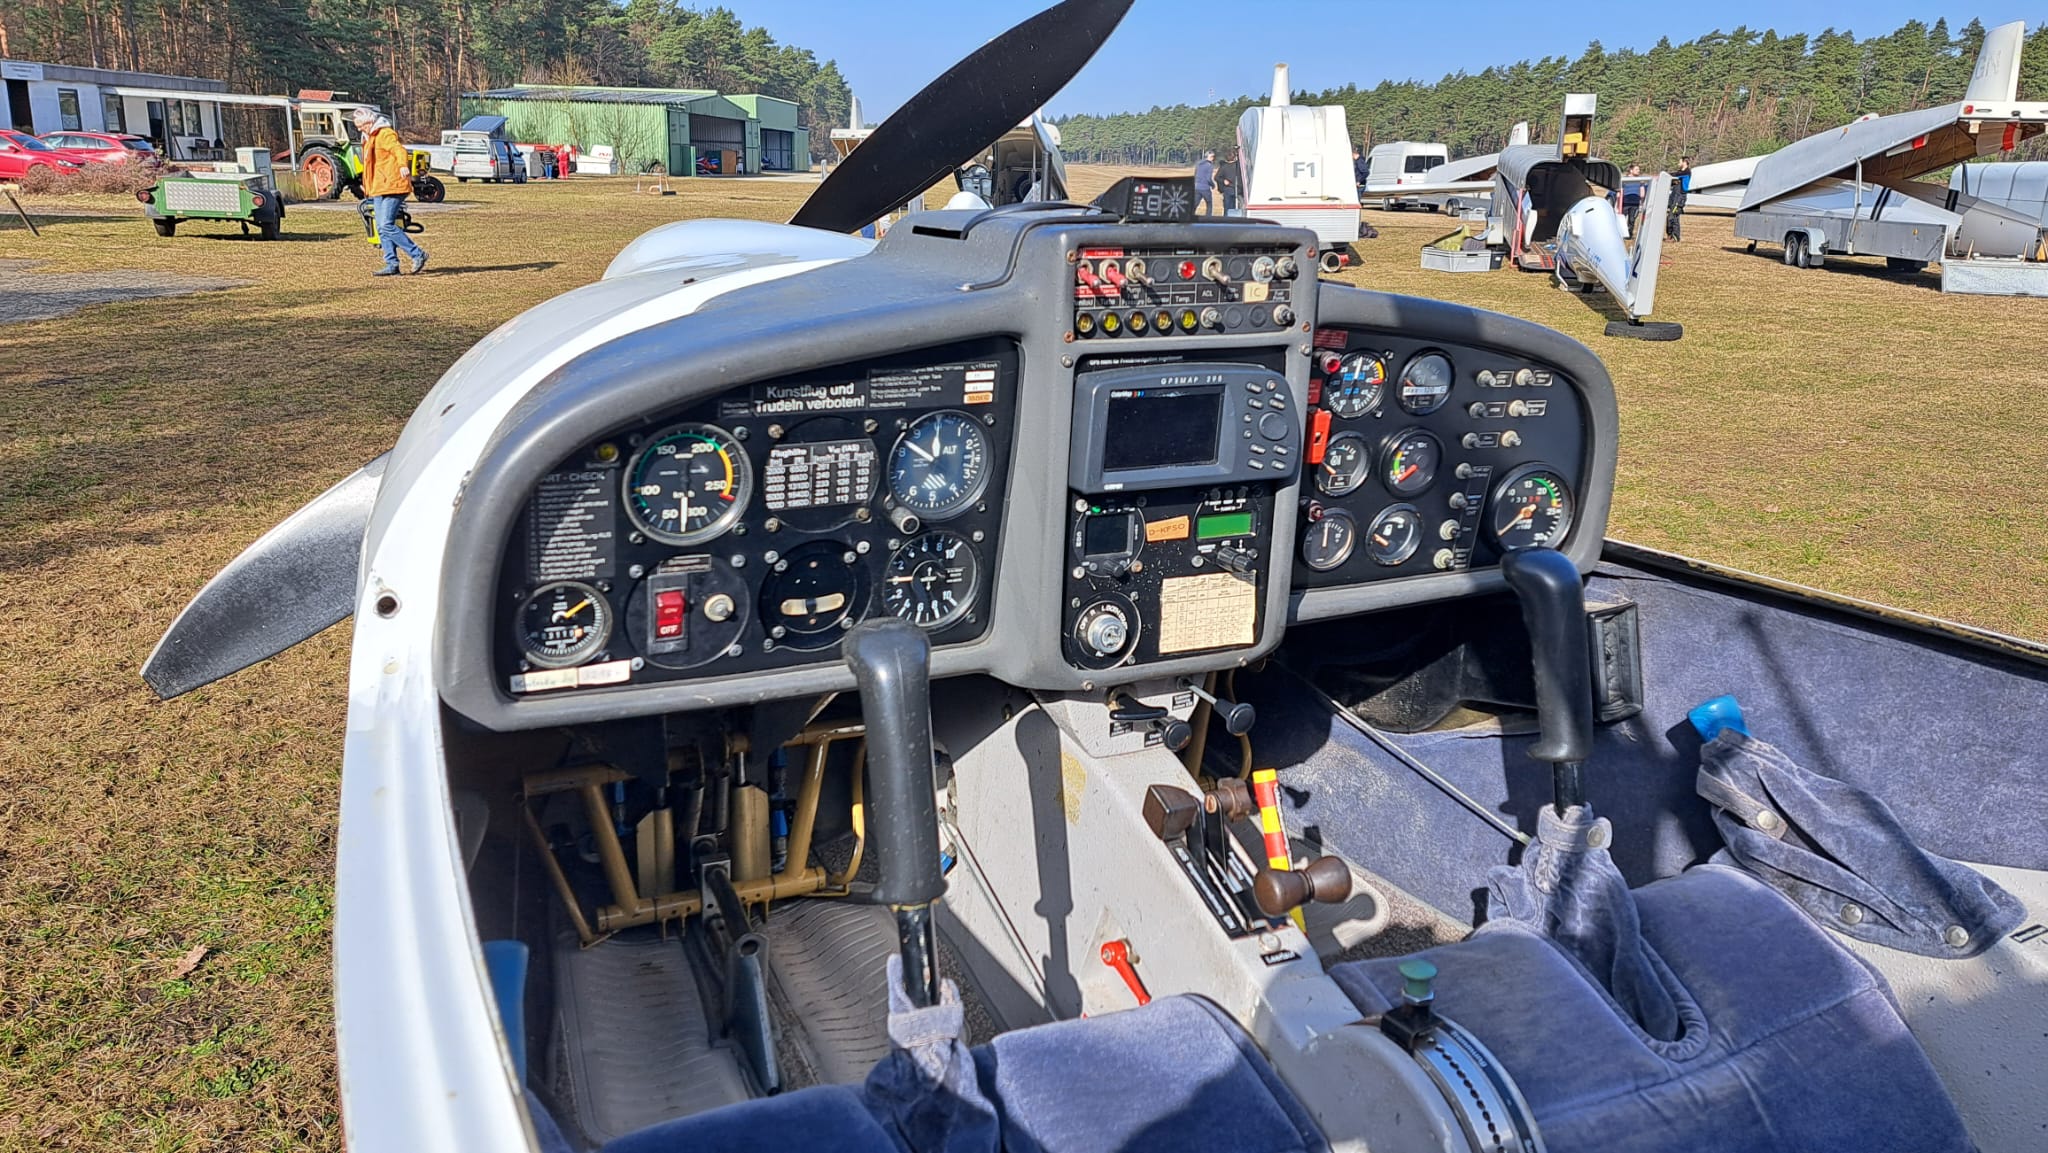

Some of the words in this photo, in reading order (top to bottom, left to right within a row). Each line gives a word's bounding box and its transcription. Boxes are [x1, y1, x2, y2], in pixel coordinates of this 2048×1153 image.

[1293, 162, 1315, 178] F1
[767, 384, 827, 399] Kunstflug
[830, 382, 855, 396] und
[755, 398, 804, 413] Trudeln
[807, 395, 865, 411] verboten!
[913, 429, 921, 439] 9
[656, 445, 676, 455] 150
[690, 443, 714, 453] 200
[898, 447, 906, 457] 8
[942, 445, 958, 455] ALT
[965, 439, 973, 450] 2
[569, 471, 605, 481] CHECK
[896, 469, 905, 480] 7
[963, 468, 970, 479] 3
[640, 484, 661, 495] 100
[704, 480, 728, 491] 250
[1524, 480, 1533, 488] 15
[909, 485, 918, 496] 6
[928, 490, 937, 501] 5
[1507, 488, 1516, 496] 10
[1536, 487, 1547, 495] 20
[662, 509, 679, 519] 50
[936, 542, 943, 551] 8
[945, 549, 955, 559] 10
[897, 560, 905, 570] 2
[895, 588, 903, 599] 2
[943, 590, 952, 600] 10
[917, 602, 924, 612] 6
[931, 599, 938, 610] 8
[660, 625, 679, 635] OFF
